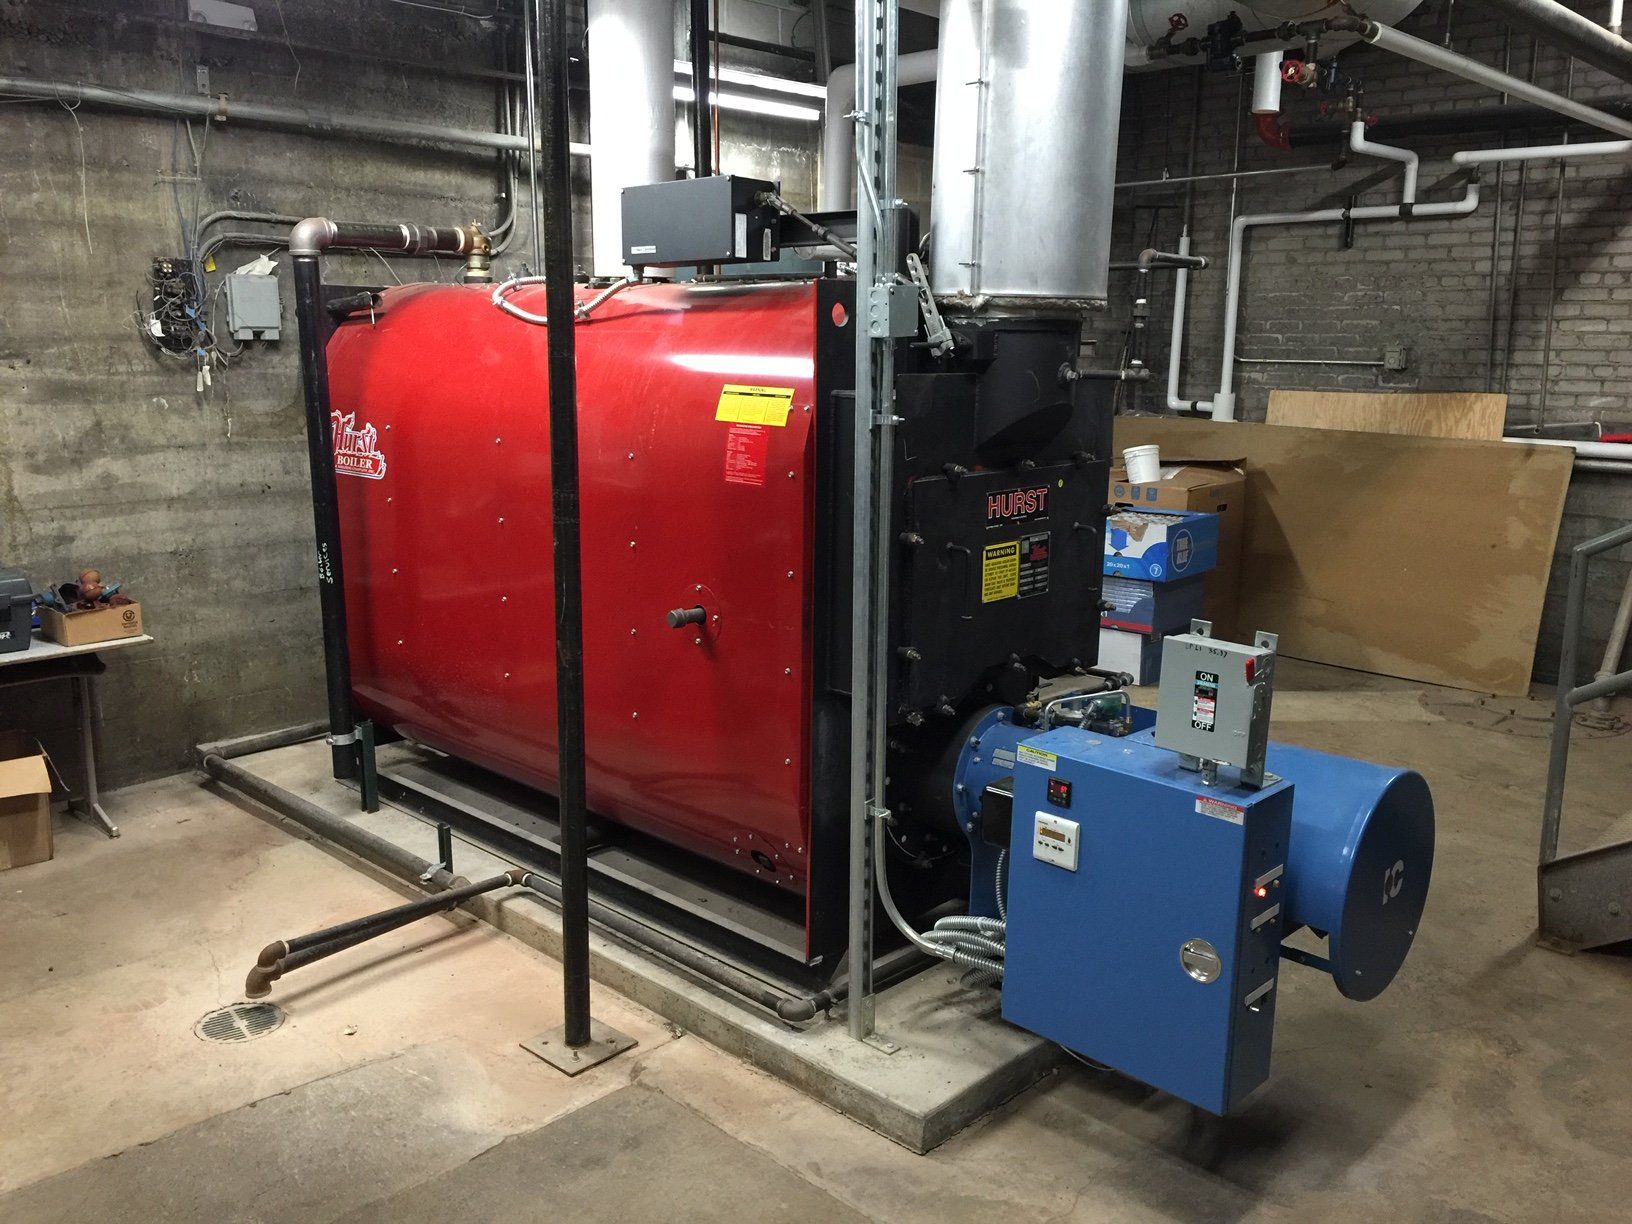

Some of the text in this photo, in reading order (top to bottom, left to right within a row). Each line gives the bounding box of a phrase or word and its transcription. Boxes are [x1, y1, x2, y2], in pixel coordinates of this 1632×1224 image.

[337, 455, 373, 469] BOILER
[988, 488, 1048, 519] HURST
[987, 546, 1016, 558] WARNING
[1200, 672, 1214, 682] ON
[1194, 720, 1212, 731] OFF
[1025, 748, 1048, 758] CAUTION
